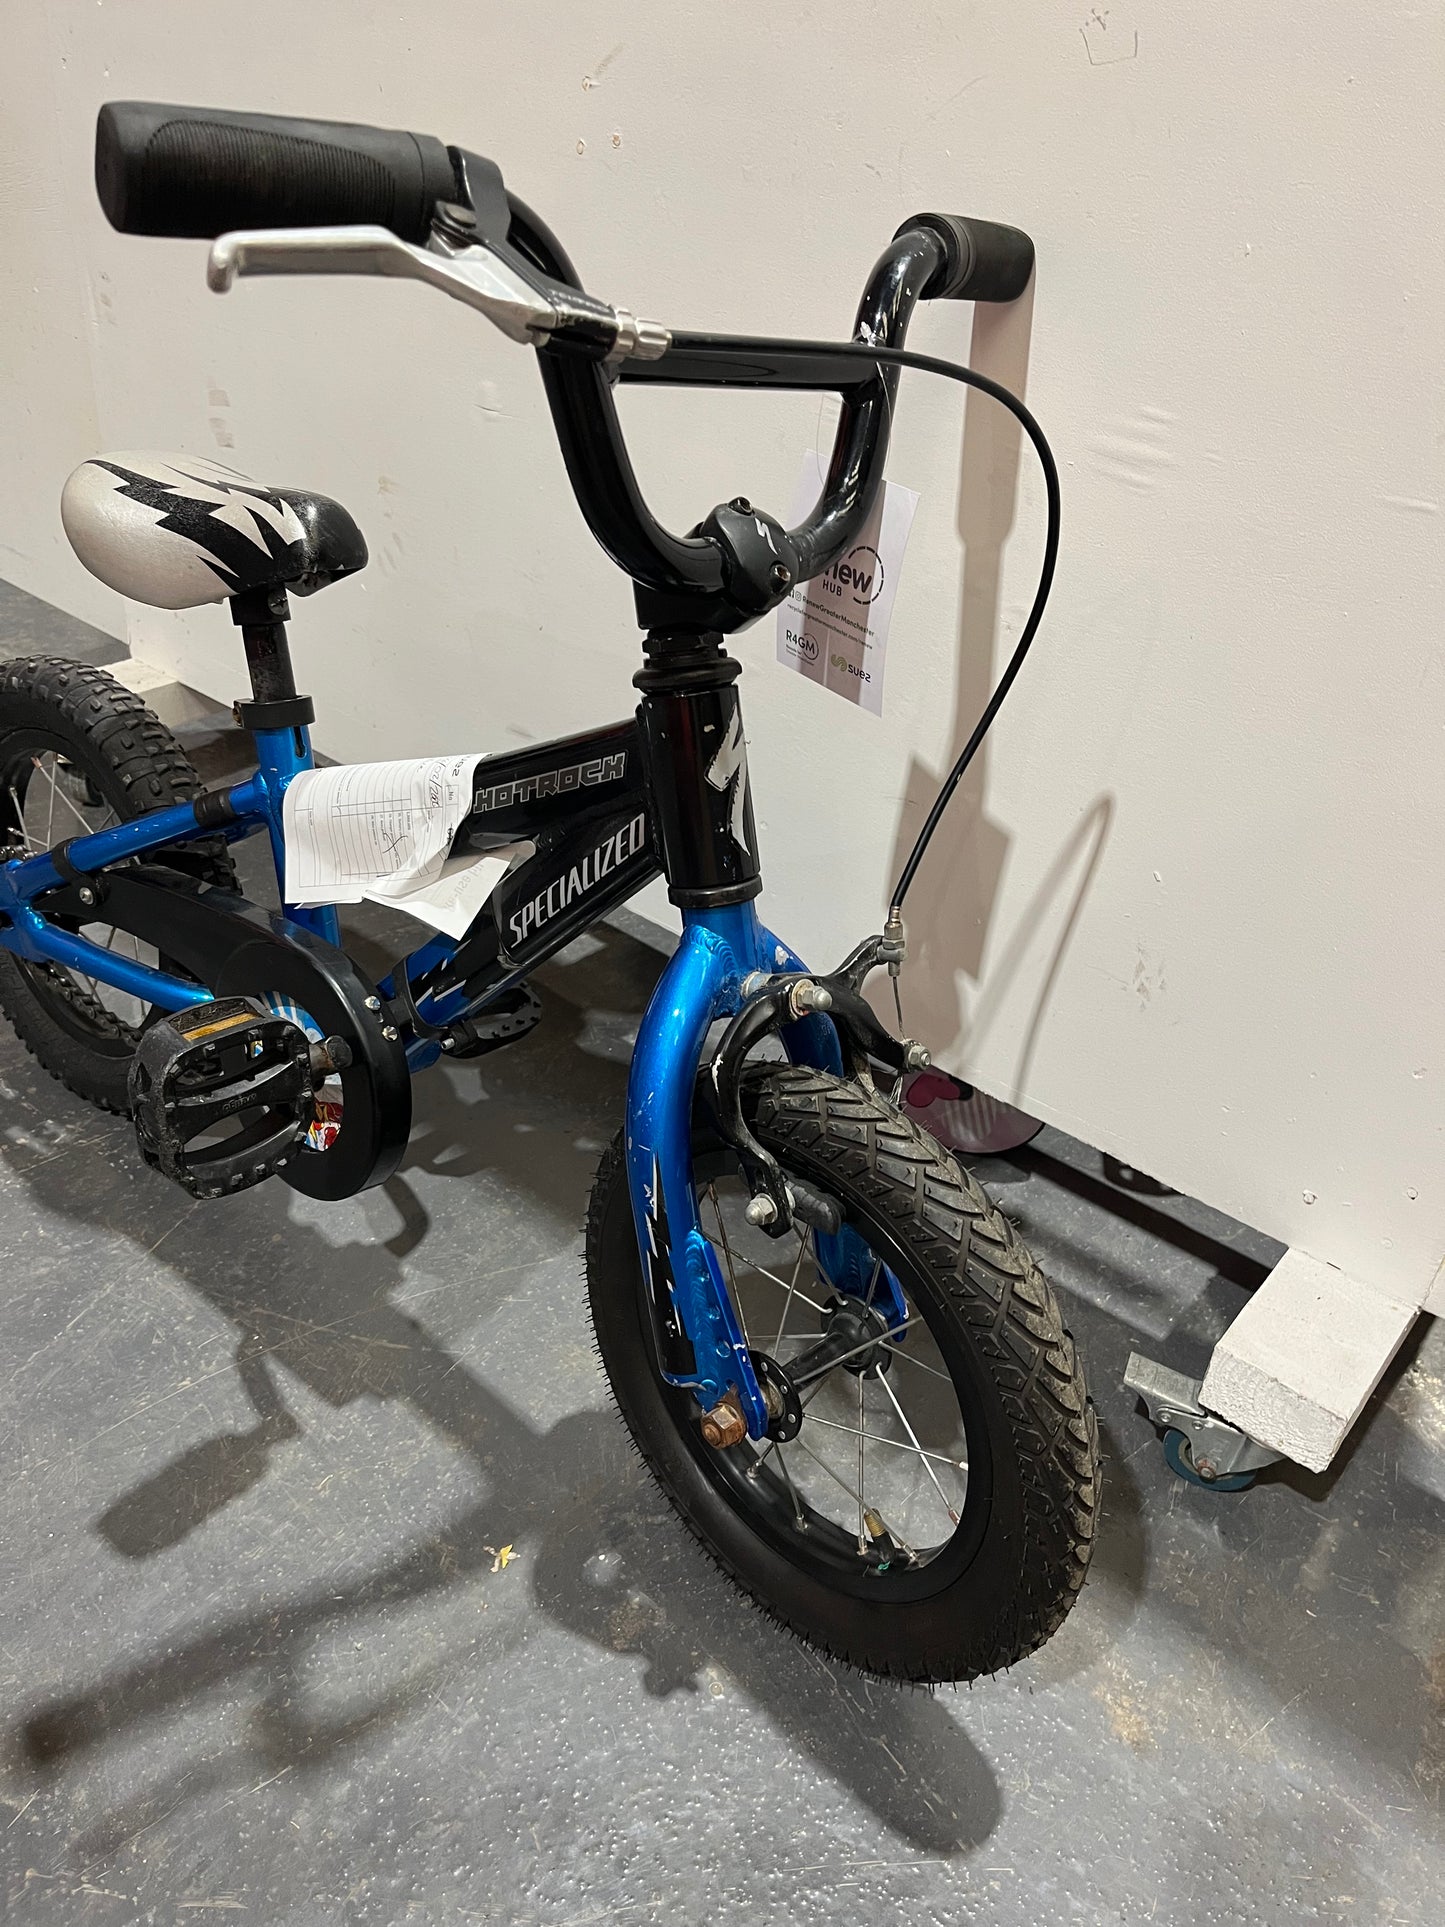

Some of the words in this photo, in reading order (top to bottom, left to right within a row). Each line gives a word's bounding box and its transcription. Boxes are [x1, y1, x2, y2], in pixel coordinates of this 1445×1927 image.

[822, 579, 842, 596] HUB
[786, 629, 815, 655] R4GM
[848, 664, 871, 683] suez
[473, 752, 626, 814] HOTROCK
[509, 812, 645, 949] SPECIALIZED
